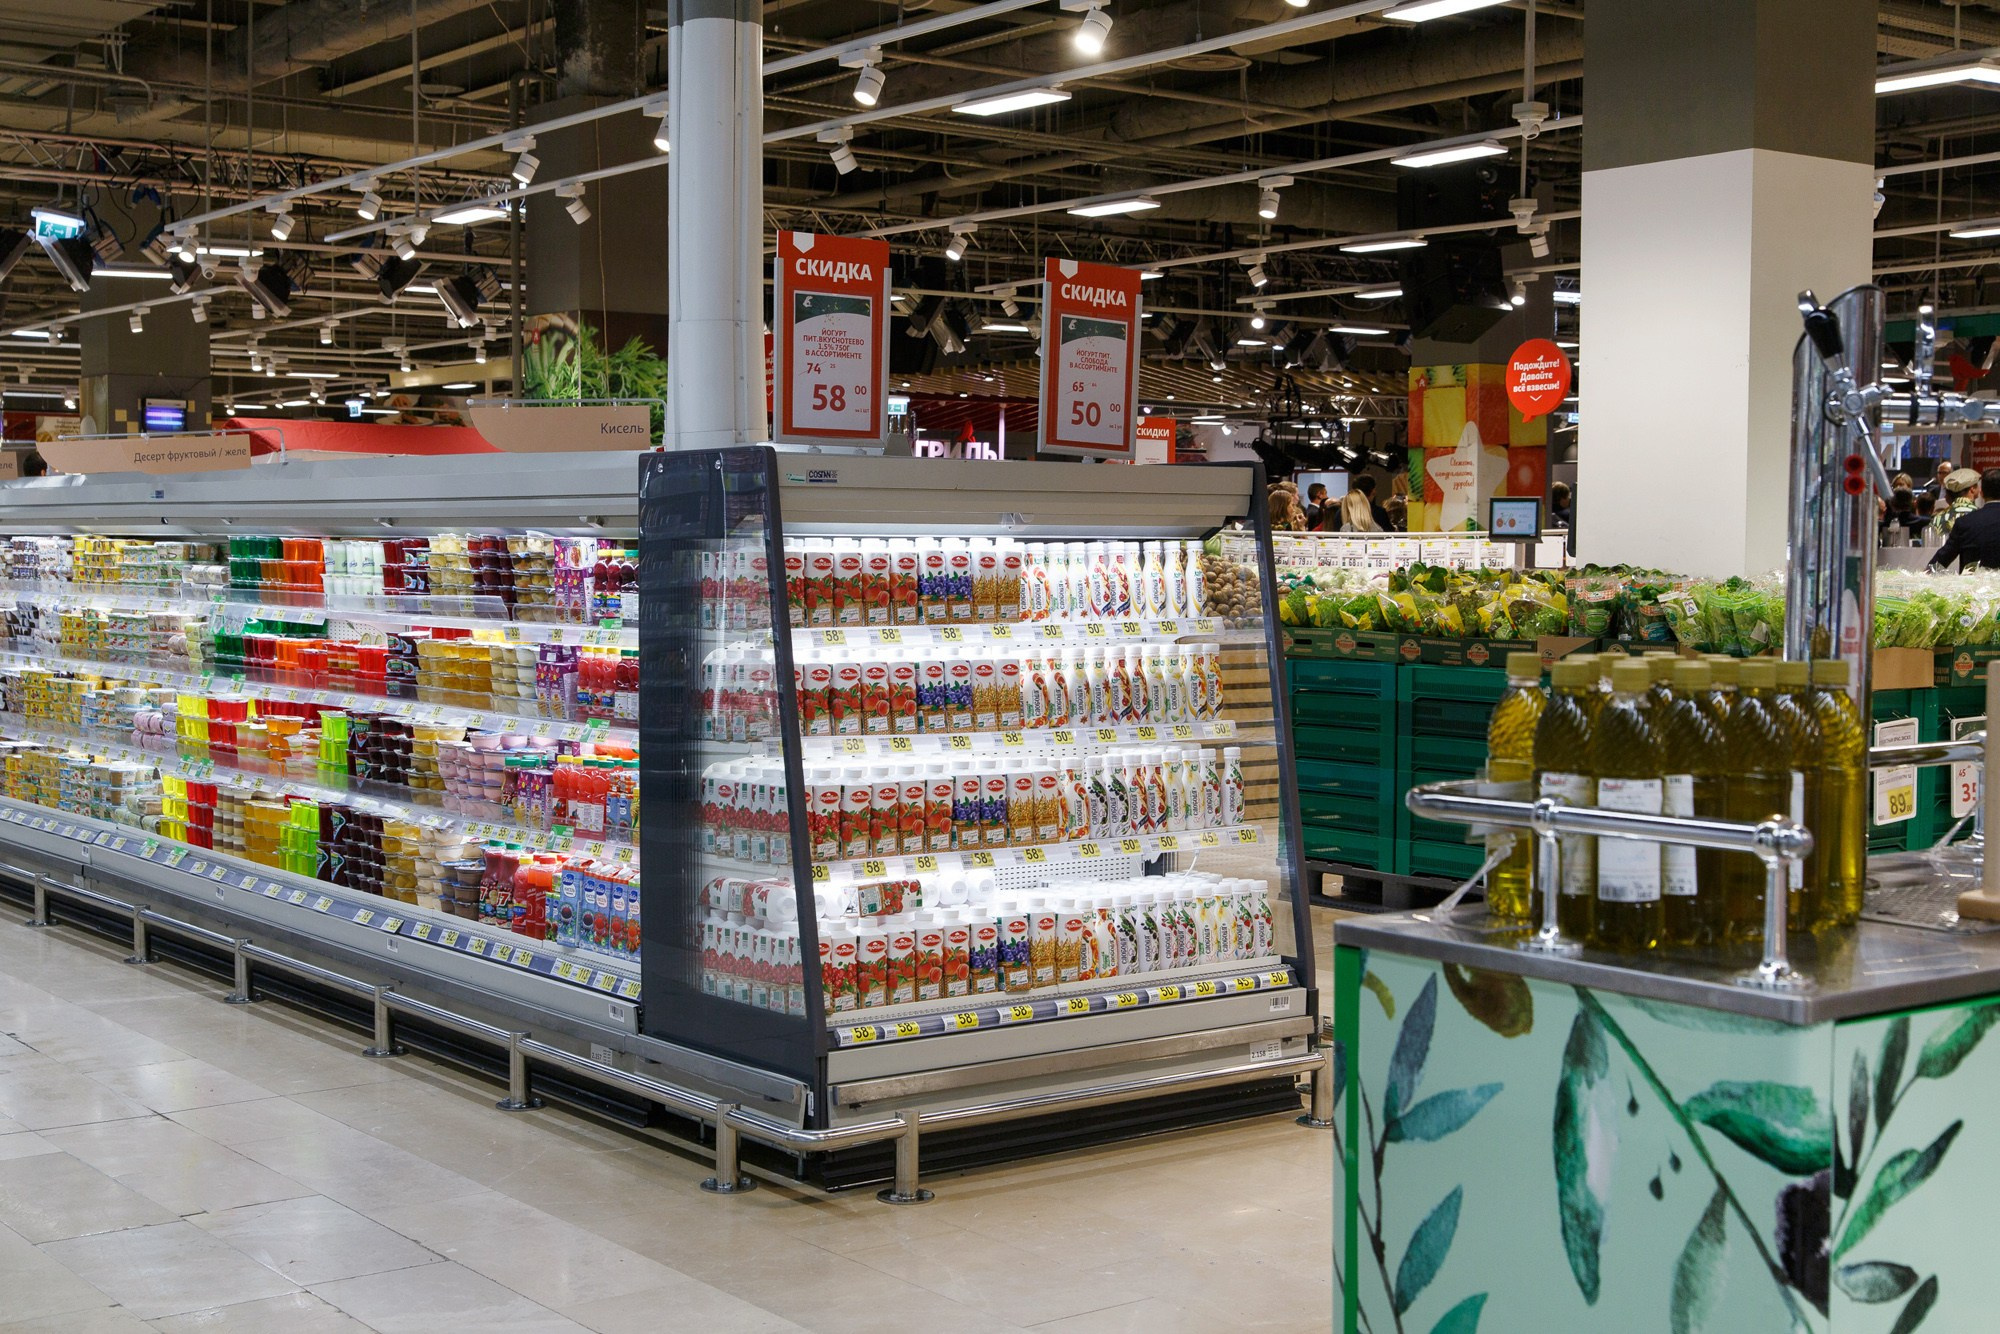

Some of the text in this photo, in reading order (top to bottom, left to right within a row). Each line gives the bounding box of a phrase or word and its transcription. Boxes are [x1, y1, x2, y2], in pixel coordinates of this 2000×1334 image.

[795, 257, 873, 284] СКИДКА
[1061, 283, 1127, 309] СКИДКА
[821, 327, 847, 337] ЙОГУРТ
[803, 335, 865, 346] ПИТ.ВКУСНОТЕЕВО
[811, 350, 862, 360] АССОРТИМЕНТЕ
[1076, 349, 1112, 360] ЙОГУРТ ПИТ.
[1080, 356, 1108, 366] СЛОБОДА
[1513, 358, 1560, 371] Подождите!
[806, 362, 822, 375] 74
[1074, 362, 1118, 374] АССОРТИМЕНТЕ
[1520, 371, 1553, 383] Давайте
[1072, 381, 1084, 392] 65
[1513, 380, 1560, 393] всё взвесим!
[812, 383, 867, 412] 58 00
[1071, 400, 1121, 427] 50 00
[600, 422, 645, 434] Кисель
[1136, 427, 1170, 438] СКИДКИ
[915, 440, 998, 460] ГРИЛЬ
[1233, 441, 1252, 449] Мясо
[133, 452, 166, 463] Десерт
[167, 448, 217, 462] фруктовый
[224, 448, 248, 457] желе
[1889, 793, 1907, 815] 89
[1271, 972, 1284, 983] 50
[1161, 986, 1173, 997] 50
[1197, 982, 1210, 993] 50
[1012, 1005, 1027, 1017] 58
[957, 1012, 973, 1025] 58
[854, 1026, 869, 1039] 58
